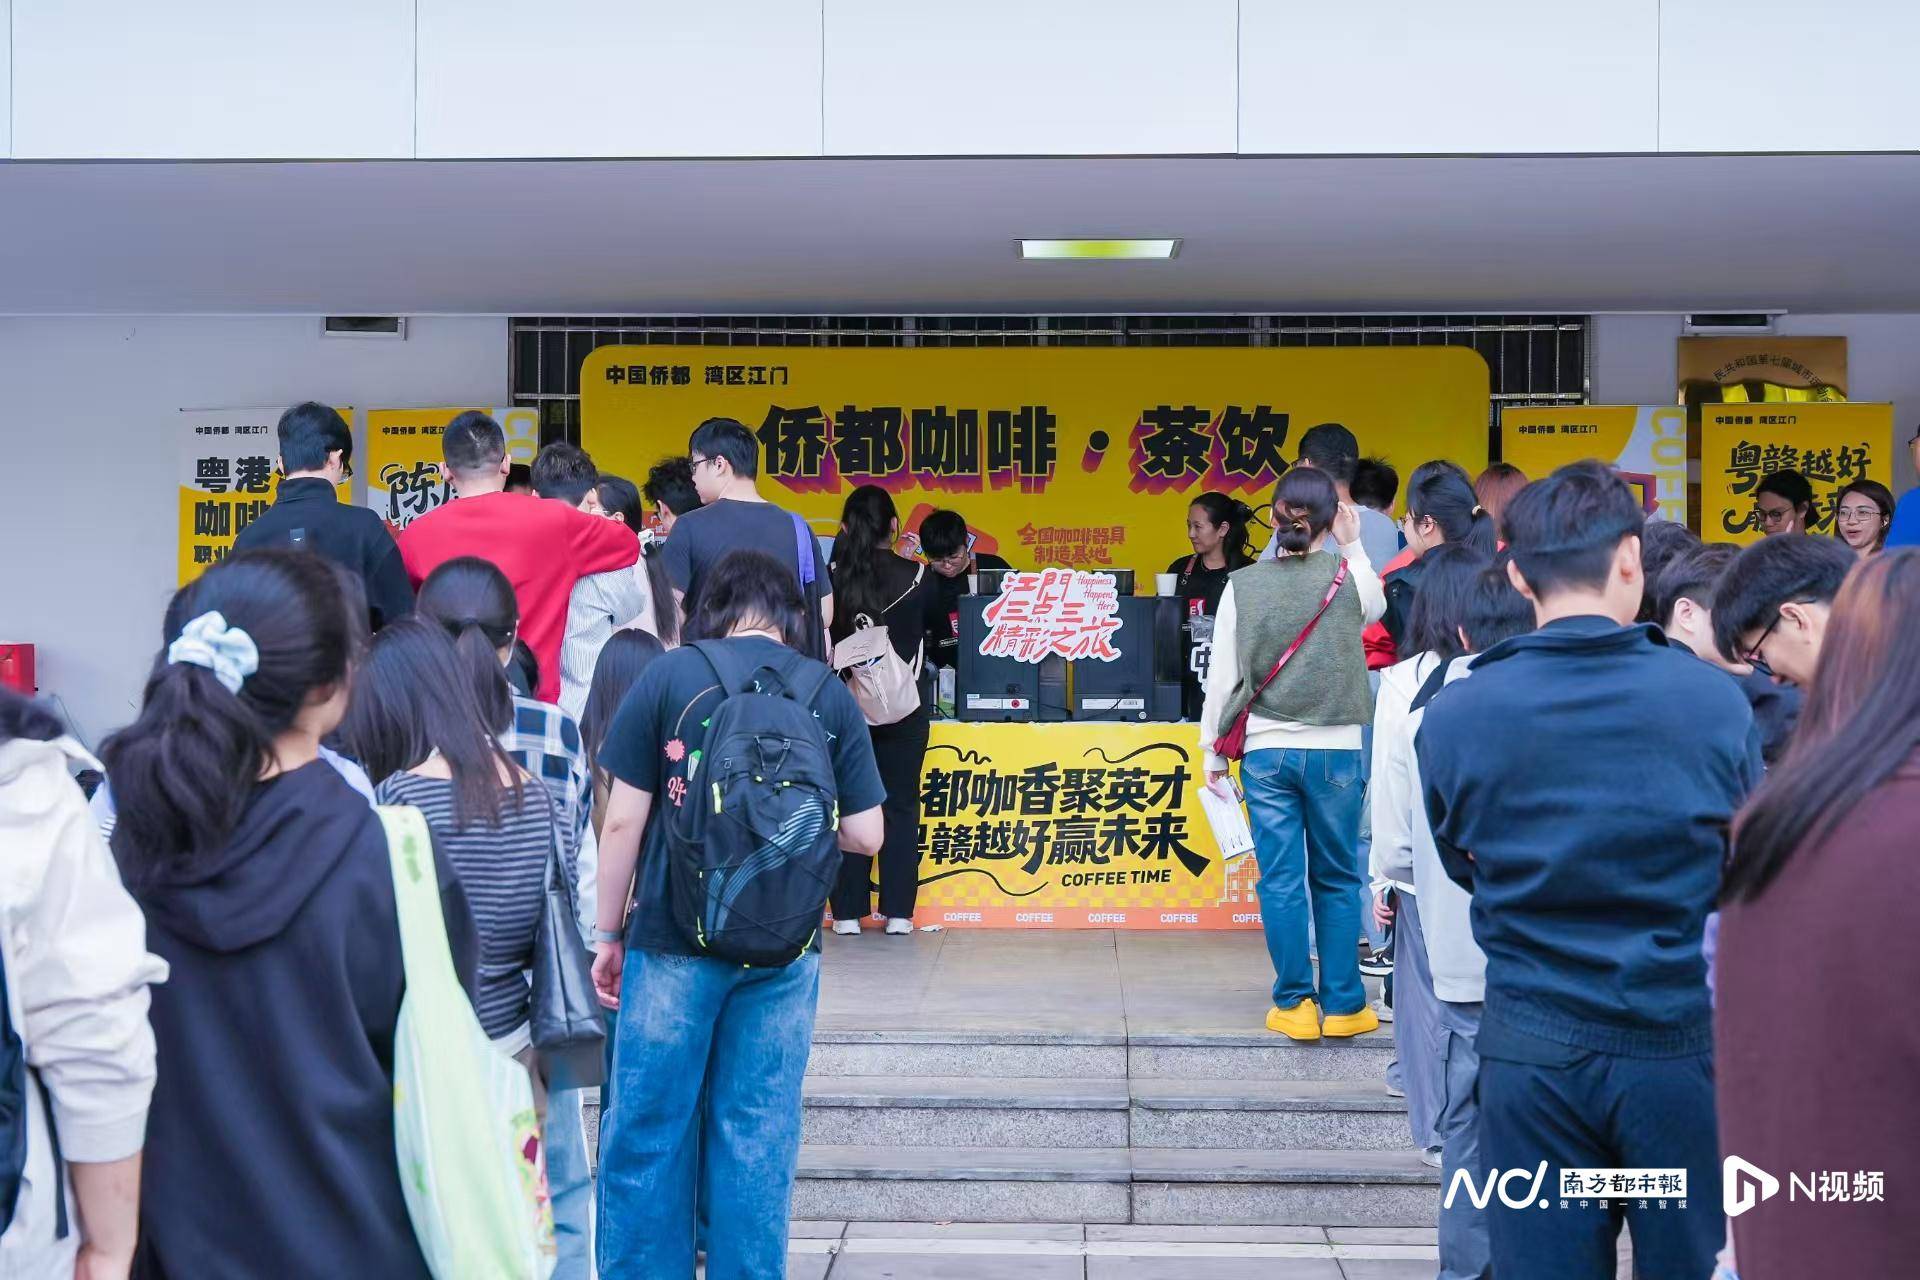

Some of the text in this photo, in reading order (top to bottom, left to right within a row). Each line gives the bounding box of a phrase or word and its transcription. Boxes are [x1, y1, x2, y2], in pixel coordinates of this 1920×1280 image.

[605, 365, 788, 385] 中国侨都 湾区江门
[1715, 416, 1797, 425] 中国侨都 湾区江门
[195, 426, 268, 435] 中国侨都 湾区江门
[382, 426, 416, 435] 中国侨都
[1518, 425, 1598, 434] 中国侨都 湾区江门
[755, 405, 1290, 479] 侨都咖啡·茶饮
[195, 456, 284, 494] 粤港
[386, 461, 451, 520] 陈
[1017, 522, 1126, 546] 全国咖啡器具
[1034, 545, 1112, 567] 制造基地
[1076, 575, 1114, 589] Happiness
[1083, 589, 1115, 603] Happens
[1096, 601, 1116, 611] Here
[983, 616, 1120, 660] 精彩之旅
[920, 761, 1192, 818] 都咖香聚英才
[1062, 869, 1172, 887] COFFEE TIME
[943, 912, 982, 922] COFFEE
[1015, 912, 1054, 922] COFFEE
[1087, 913, 1126, 923] COFFEE
[1160, 913, 1198, 923] COFFEE
